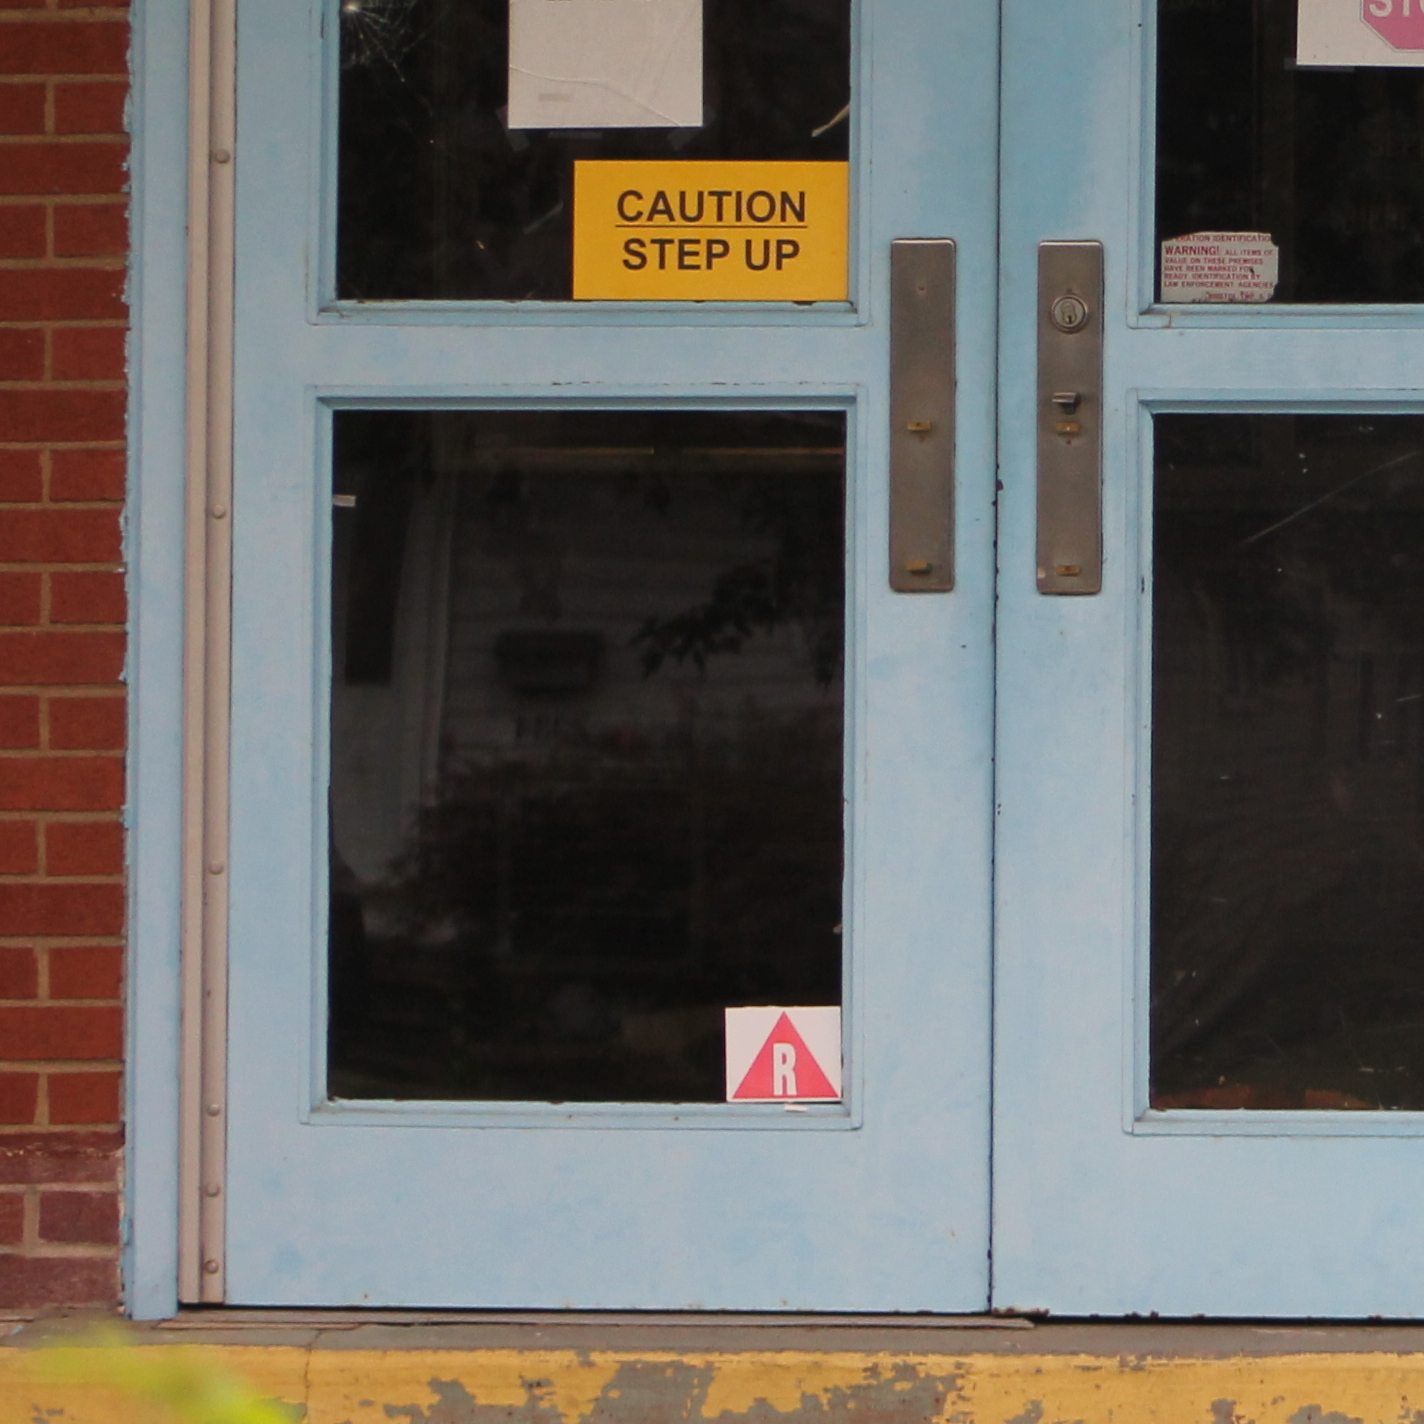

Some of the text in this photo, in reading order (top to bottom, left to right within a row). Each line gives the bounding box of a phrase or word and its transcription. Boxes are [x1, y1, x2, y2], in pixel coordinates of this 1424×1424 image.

[617, 189, 806, 222] CAUTION
[622, 238, 800, 270] STEP UP
[1164, 246, 1219, 255] WARNING!
[773, 1042, 798, 1096] R
